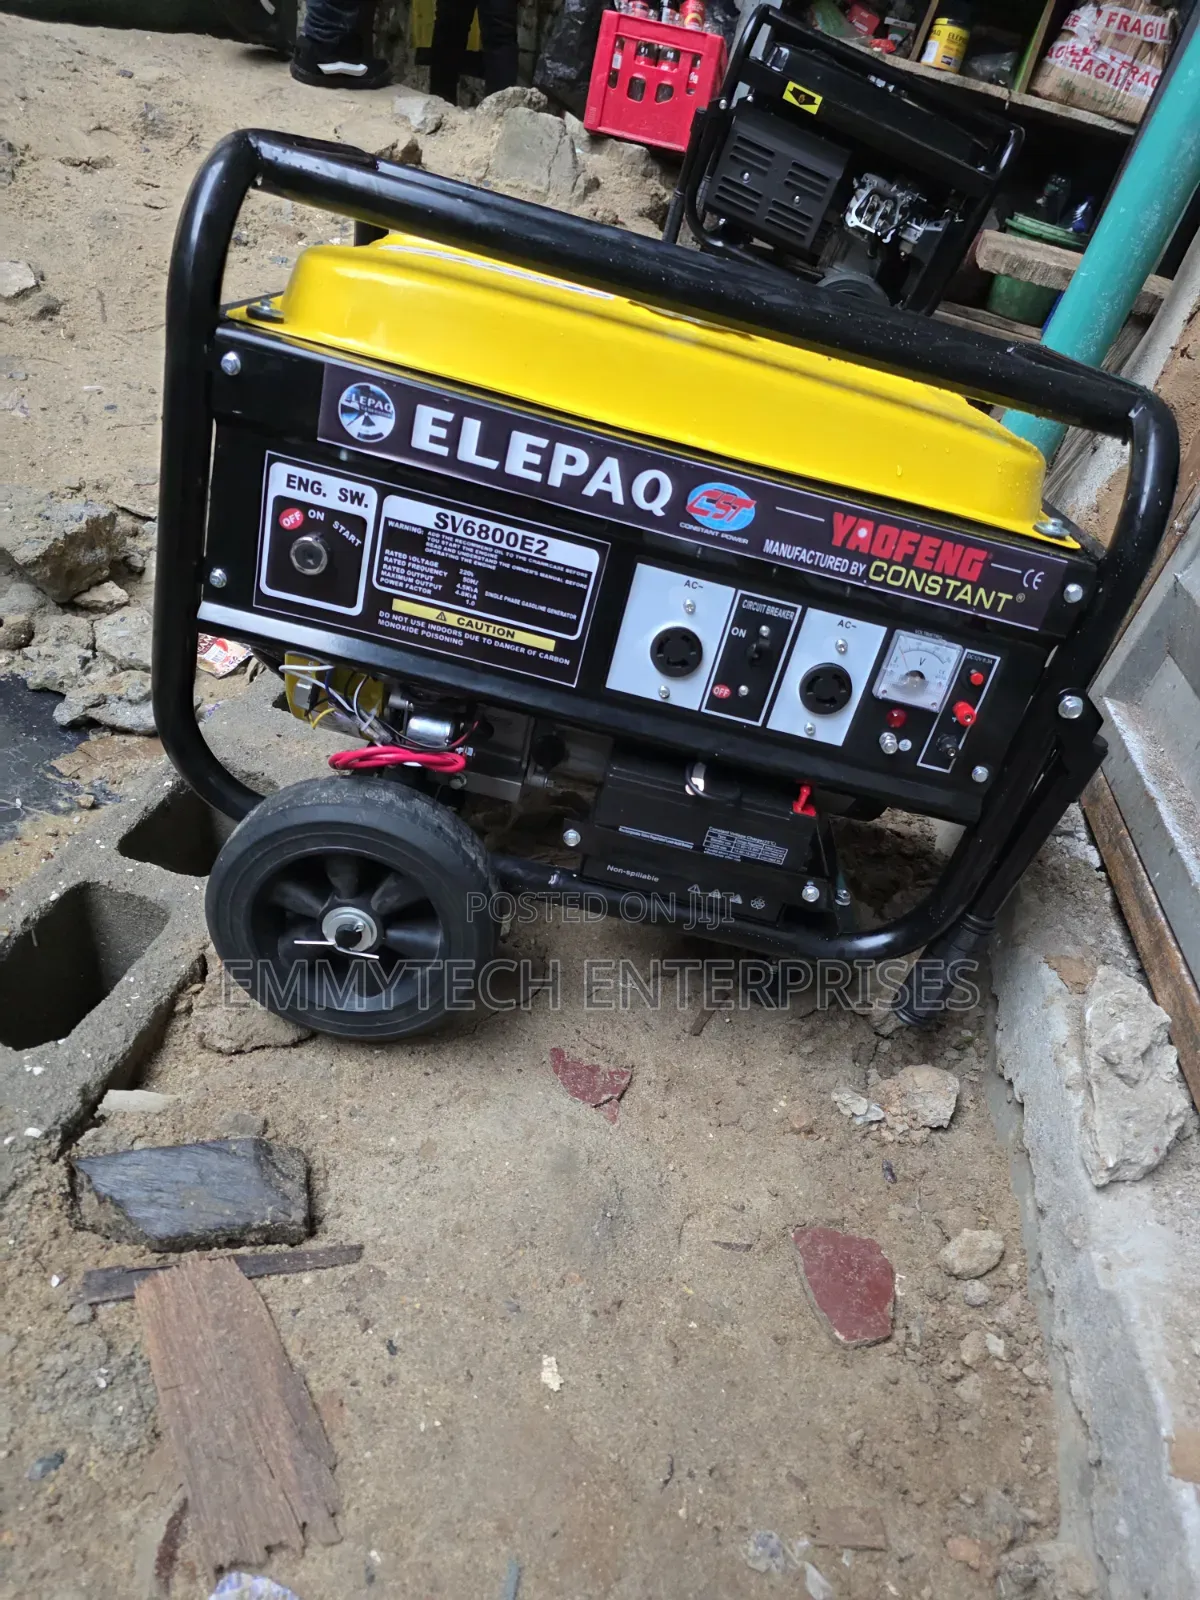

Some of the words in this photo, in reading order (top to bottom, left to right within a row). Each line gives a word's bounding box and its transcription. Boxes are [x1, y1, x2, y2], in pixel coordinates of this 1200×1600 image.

[411, 404, 673, 516] ELEPAQ
[286, 473, 327, 498] ENG.
[338, 487, 368, 508] SW.
[308, 509, 325, 521] ON
[686, 489, 757, 522] CST
[282, 510, 302, 527] OFF
[388, 520, 424, 535] WARNING:
[332, 520, 362, 547] START
[434, 512, 549, 557] SV6800E2
[679, 522, 720, 536] CONSTANT
[721, 533, 749, 545] POWER
[384, 548, 407, 560] RATED
[408, 555, 440, 568] VOLTAGE
[427, 536, 440, 544] YOU
[441, 539, 461, 548] START
[475, 548, 498, 559] ENGINE
[427, 531, 440, 539] ADD
[441, 534, 454, 542] THE
[455, 538, 493, 552] RECOMMEND
[494, 548, 504, 556] OIL
[565, 566, 588, 578] BEFORE
[763, 538, 849, 573] MANUFACTURED
[850, 560, 867, 577] BY
[832, 512, 988, 582] YAOFENG
[383, 555, 407, 567] RATED
[407, 562, 449, 578] FREQUENCY
[424, 547, 459, 561] OPERATING
[460, 556, 473, 564] THE
[473, 559, 497, 571] ENGINE
[425, 541, 442, 550] READ
[443, 546, 456, 554] AND
[457, 549, 497, 565] UNDERSTAND
[540, 572, 564, 583] MANUAL
[565, 579, 588, 590] BEFORE
[380, 570, 414, 583] MAXIMUM
[414, 578, 443, 591] OUTPUT
[382, 563, 406, 574] RATED
[406, 569, 435, 582] OUTPUT
[1023, 568, 1045, 590] CE
[379, 577, 404, 588] POWER
[404, 583, 432, 595] FACTOR
[868, 560, 1013, 612] CONSTANT
[484, 590, 503, 601] SINGLE
[503, 595, 521, 606] PHASE
[521, 600, 547, 613] GASOLINE
[546, 607, 577, 620] GENERATOR
[741, 599, 765, 614] CIRCUIT
[765, 605, 795, 621] BREAKER
[377, 618, 420, 635] MONOXIDE
[420, 629, 464, 646] POISONING
[378, 610, 391, 619] DO
[392, 613, 409, 623] NOT
[410, 618, 426, 628] USE
[427, 623, 463, 638] INDOORS
[464, 632, 480, 642] DUE
[482, 637, 493, 646] TO
[493, 640, 526, 655] DANGER
[526, 648, 538, 657] OF
[538, 651, 571, 666] CARBON
[456, 616, 516, 640] CAUTION
[731, 626, 747, 638] ON
[919, 657, 926, 666] V
[713, 686, 731, 697] OFF
[606, 864, 660, 882] Non-spillable
